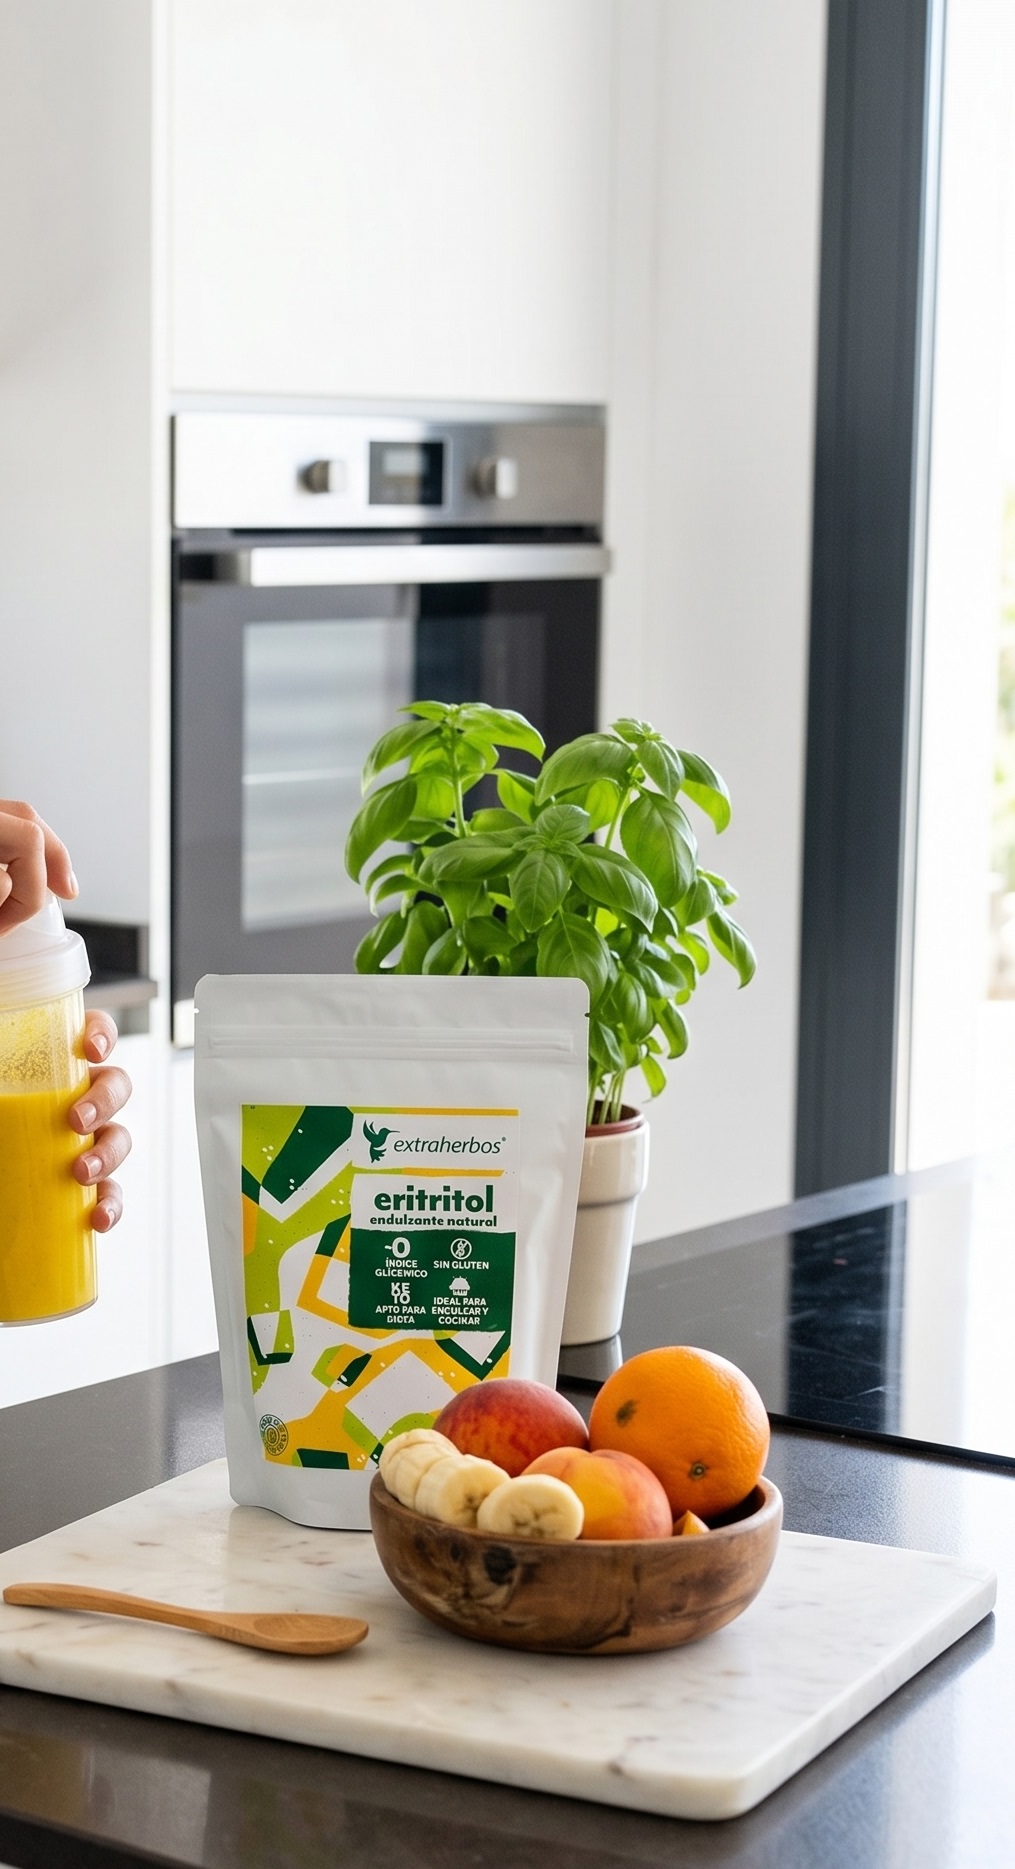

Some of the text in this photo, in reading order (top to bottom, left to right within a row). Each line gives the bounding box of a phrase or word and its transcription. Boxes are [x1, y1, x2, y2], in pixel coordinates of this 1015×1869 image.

[374, 1185, 494, 1213] eritritol
[370, 1214, 497, 1227] endulzante natural
[433, 1260, 490, 1270] SIN GLUTEN
[433, 1297, 487, 1306] IDEAL PARA
[375, 1305, 426, 1314] APTO PARA
[482, 1307, 489, 1316] Y
